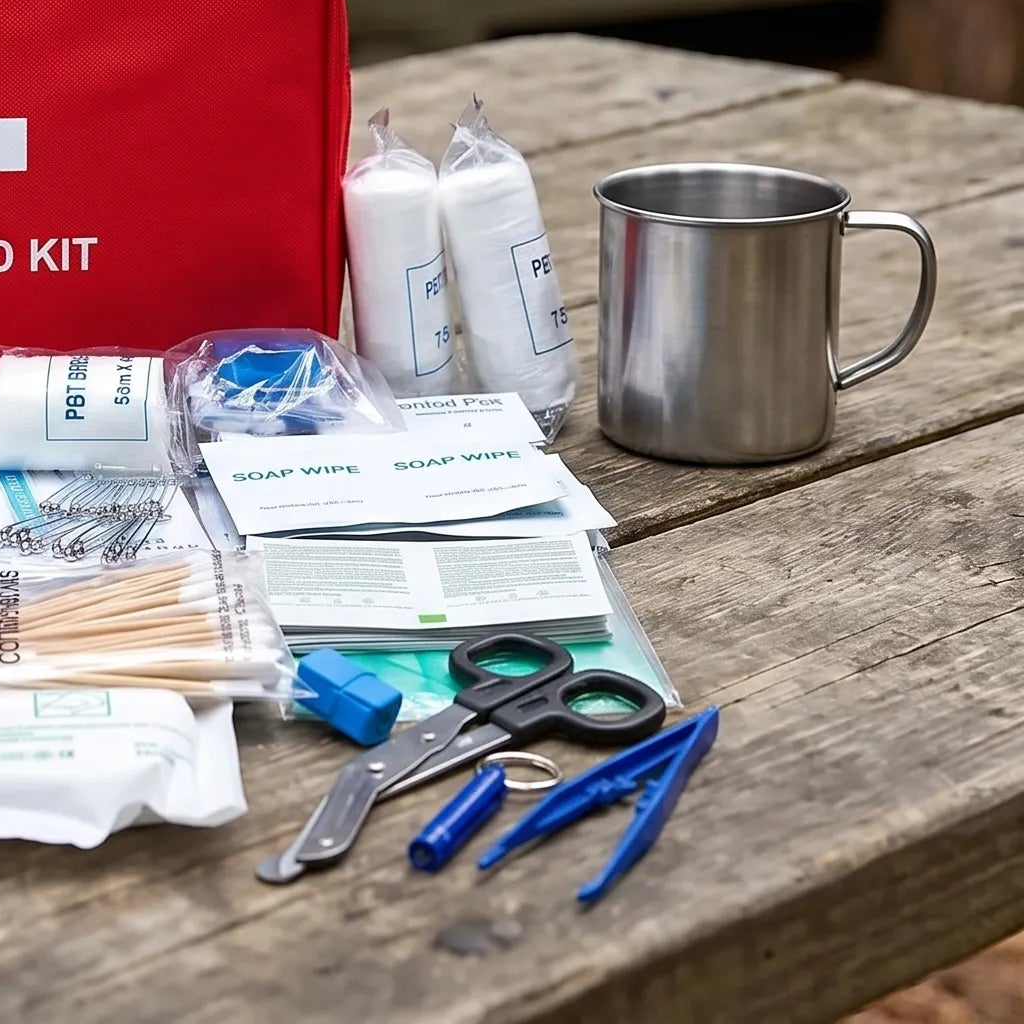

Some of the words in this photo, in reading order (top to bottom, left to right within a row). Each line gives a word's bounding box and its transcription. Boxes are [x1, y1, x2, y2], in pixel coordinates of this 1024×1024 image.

[30, 237, 98, 272] KIT
[393, 456, 455, 471] SOAP
[460, 450, 522, 461] WIPE
[232, 469, 294, 482] SOAP
[300, 465, 361, 475] WIPE
